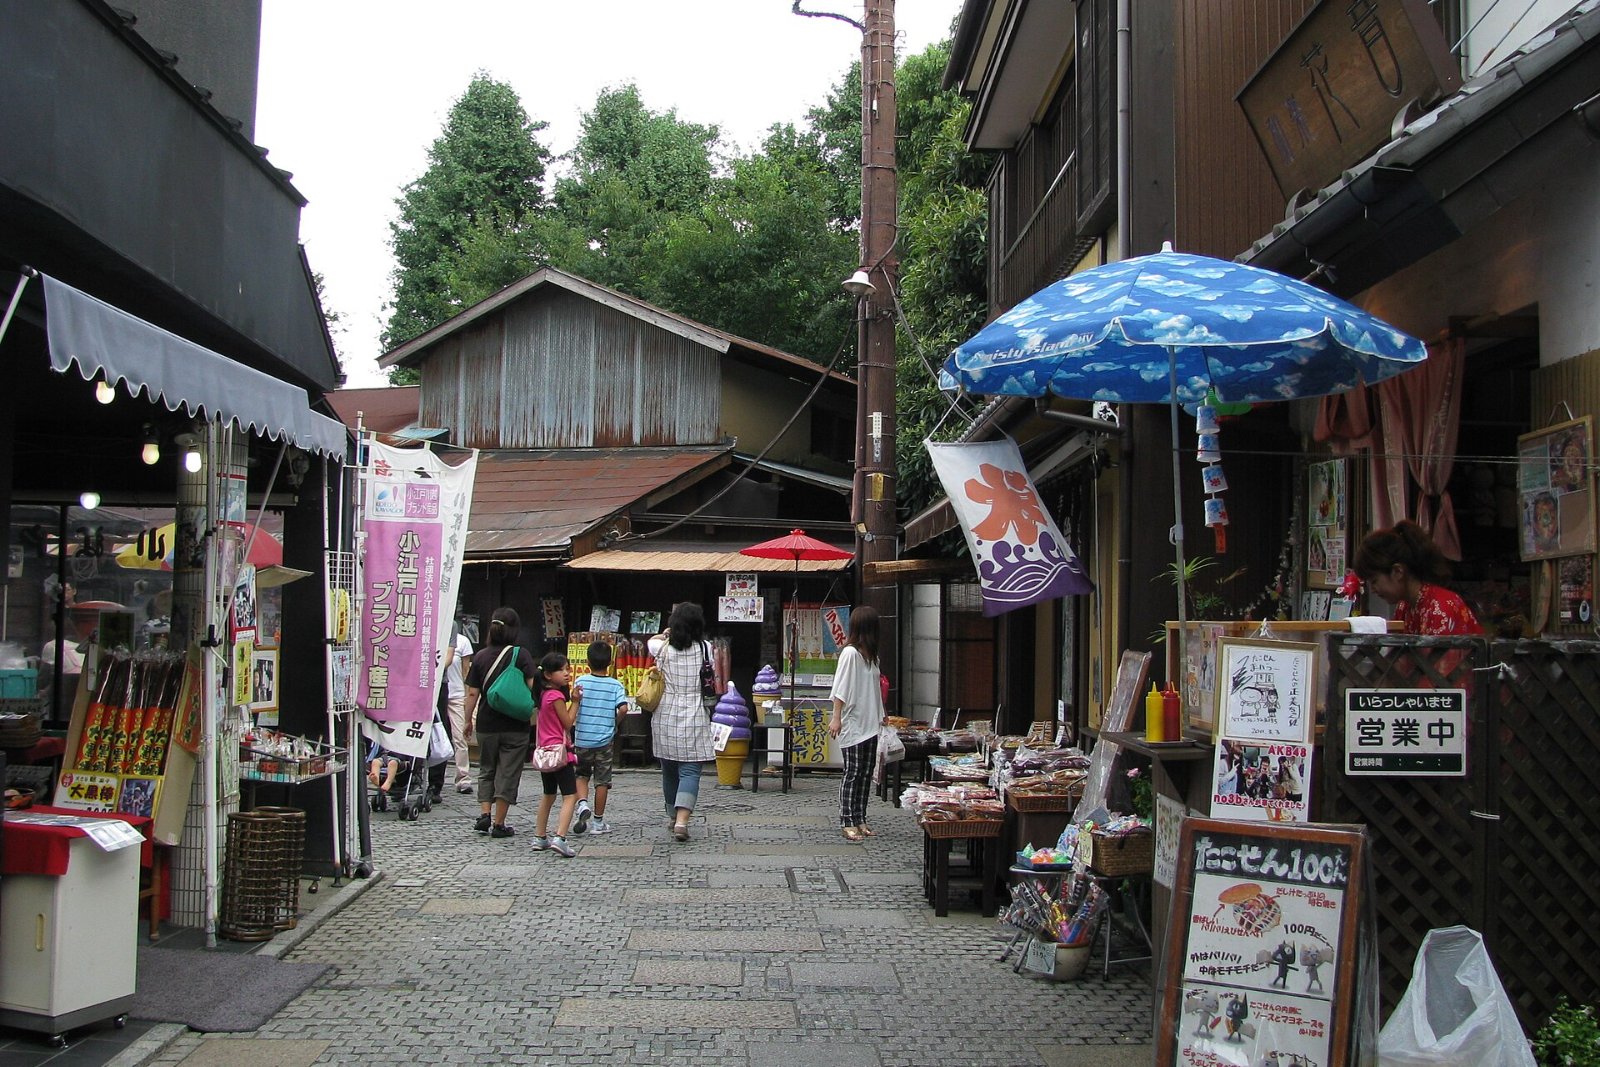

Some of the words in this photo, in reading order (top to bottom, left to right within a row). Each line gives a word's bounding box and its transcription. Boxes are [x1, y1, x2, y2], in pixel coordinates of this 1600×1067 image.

[393, 530, 421, 637] 小江戸川越
[419, 556, 435, 688] 社団法人小江戸川越観光協会認定
[825, 610, 847, 646] ラムネ
[366, 582, 394, 710] ブランド産品
[1359, 696, 1453, 708] いらっしゃいませ
[811, 709, 827, 763] 昔ながらの
[1356, 717, 1455, 747] 営業中
[1268, 745, 1307, 758] AKB48
[1353, 757, 1383, 767] 営業時間
[70, 783, 115, 801] 大黒棒
